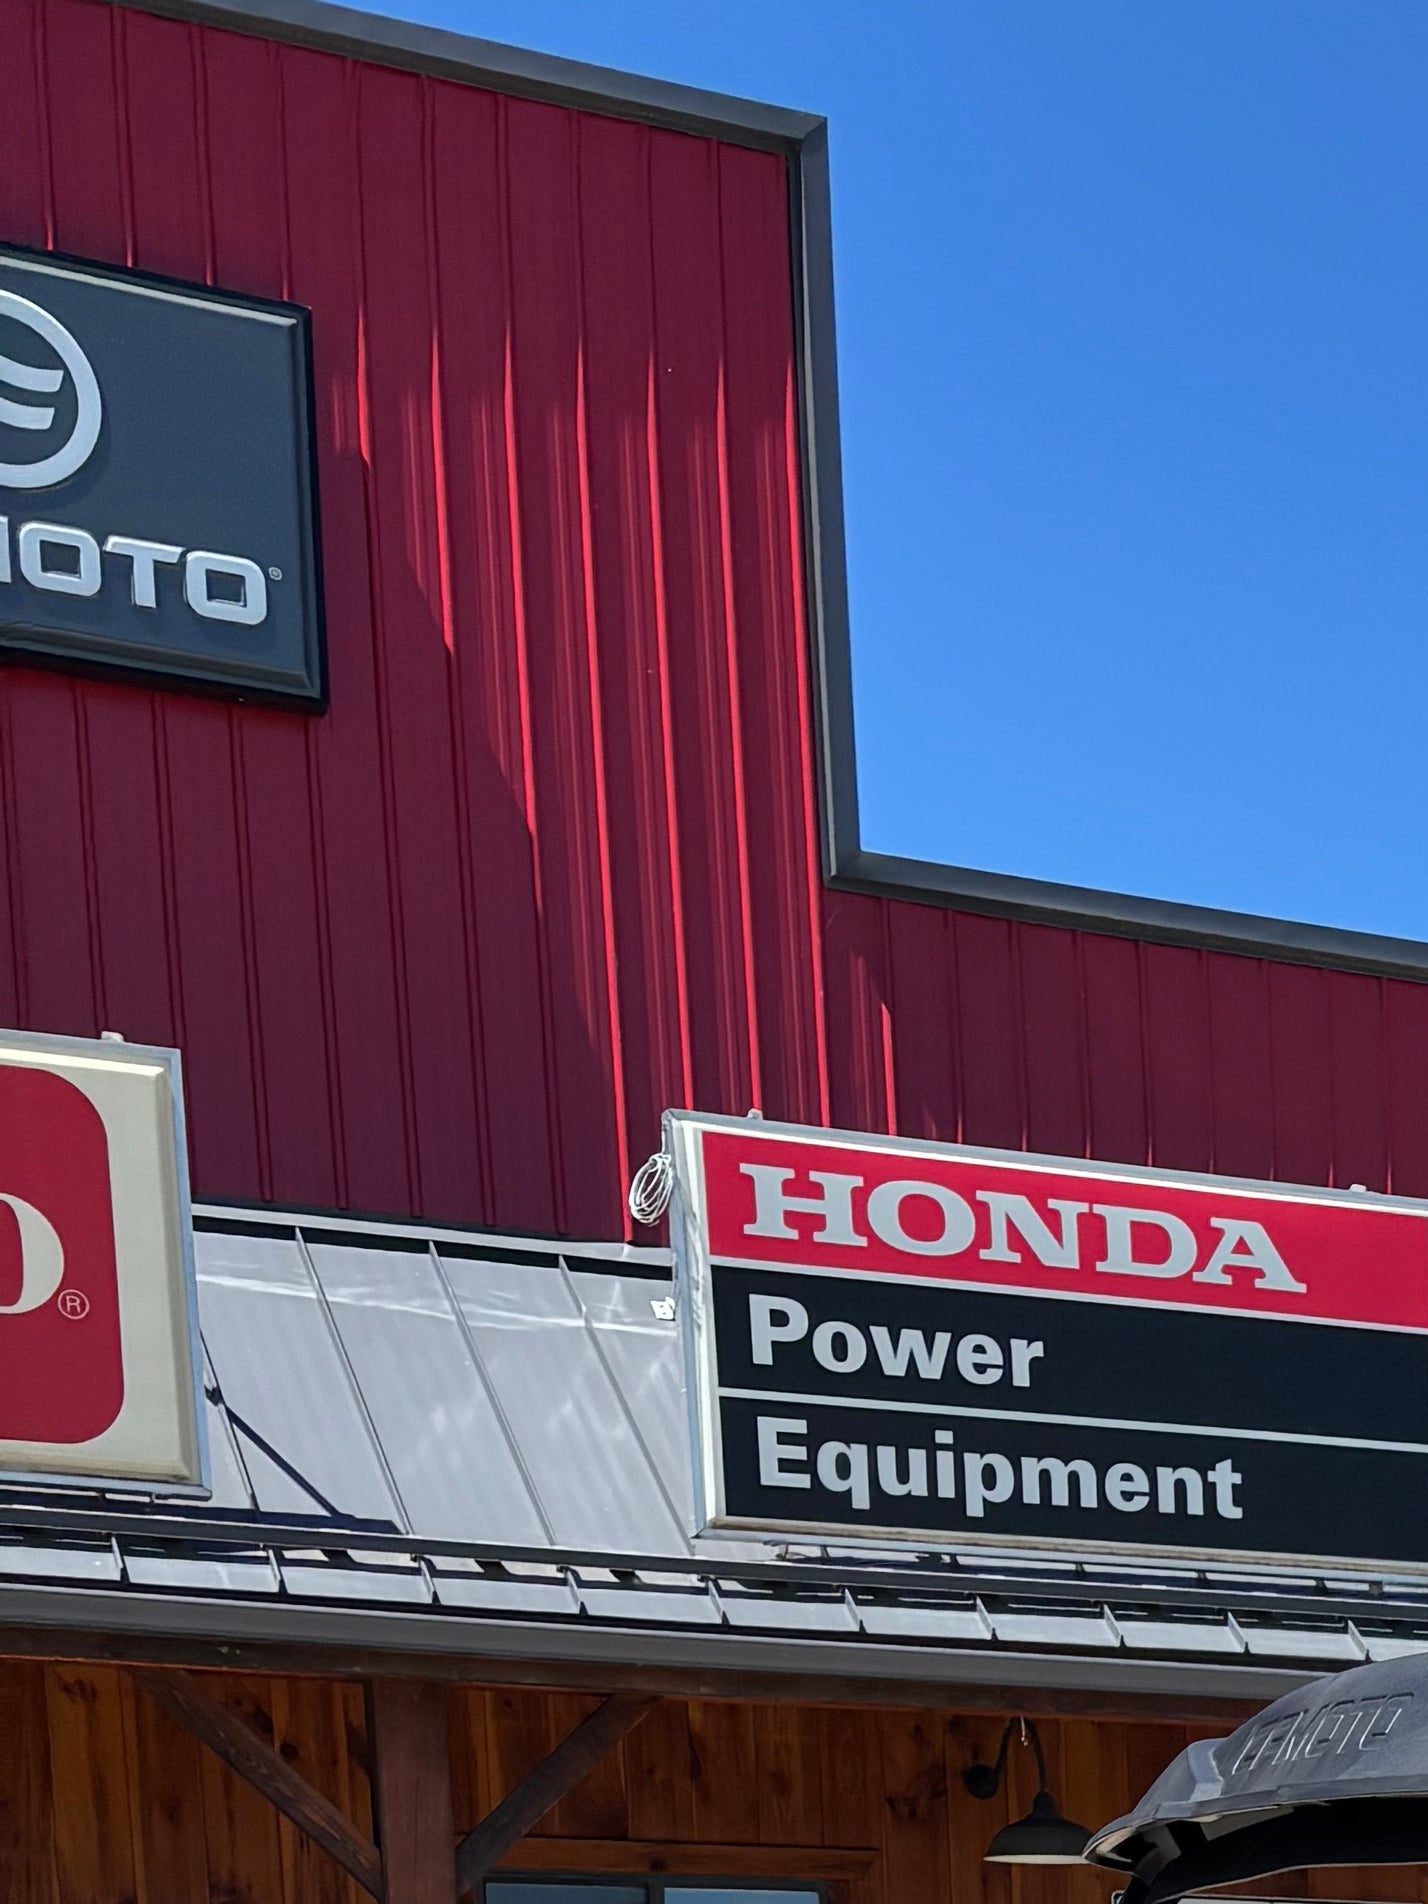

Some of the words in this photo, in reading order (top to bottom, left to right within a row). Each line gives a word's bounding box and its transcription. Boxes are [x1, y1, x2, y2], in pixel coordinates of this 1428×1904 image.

[0, 516, 267, 625] OTO
[739, 1162, 1307, 1295] HONDA
[748, 1293, 1045, 1388] Power
[756, 1415, 1244, 1520] Equipment
